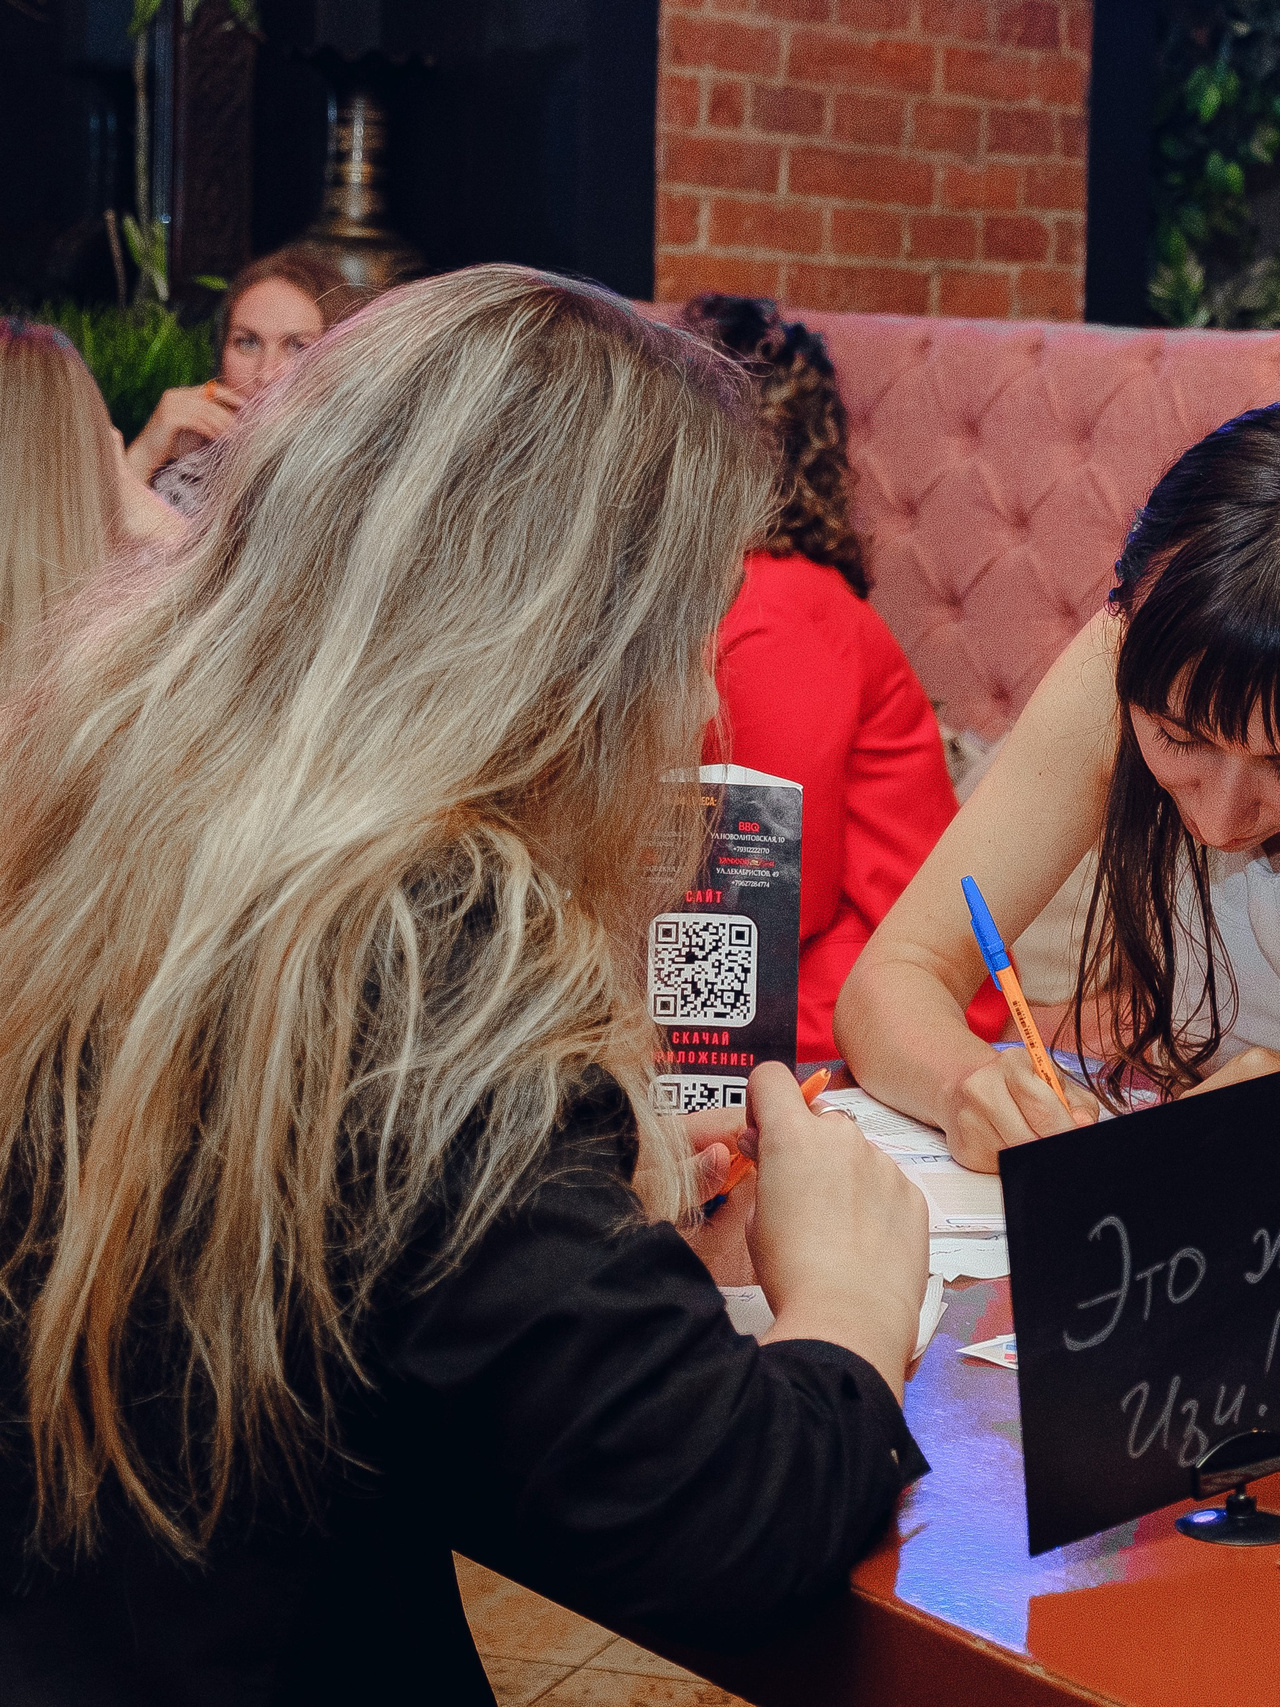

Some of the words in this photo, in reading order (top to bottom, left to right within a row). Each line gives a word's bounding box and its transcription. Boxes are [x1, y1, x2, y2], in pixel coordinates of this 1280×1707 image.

[738, 821, 760, 833] BBQ
[685, 888, 722, 904] САЙТ
[672, 1031, 730, 1046] СКАЧАЙ
[1062, 1214, 1207, 1351] Это
